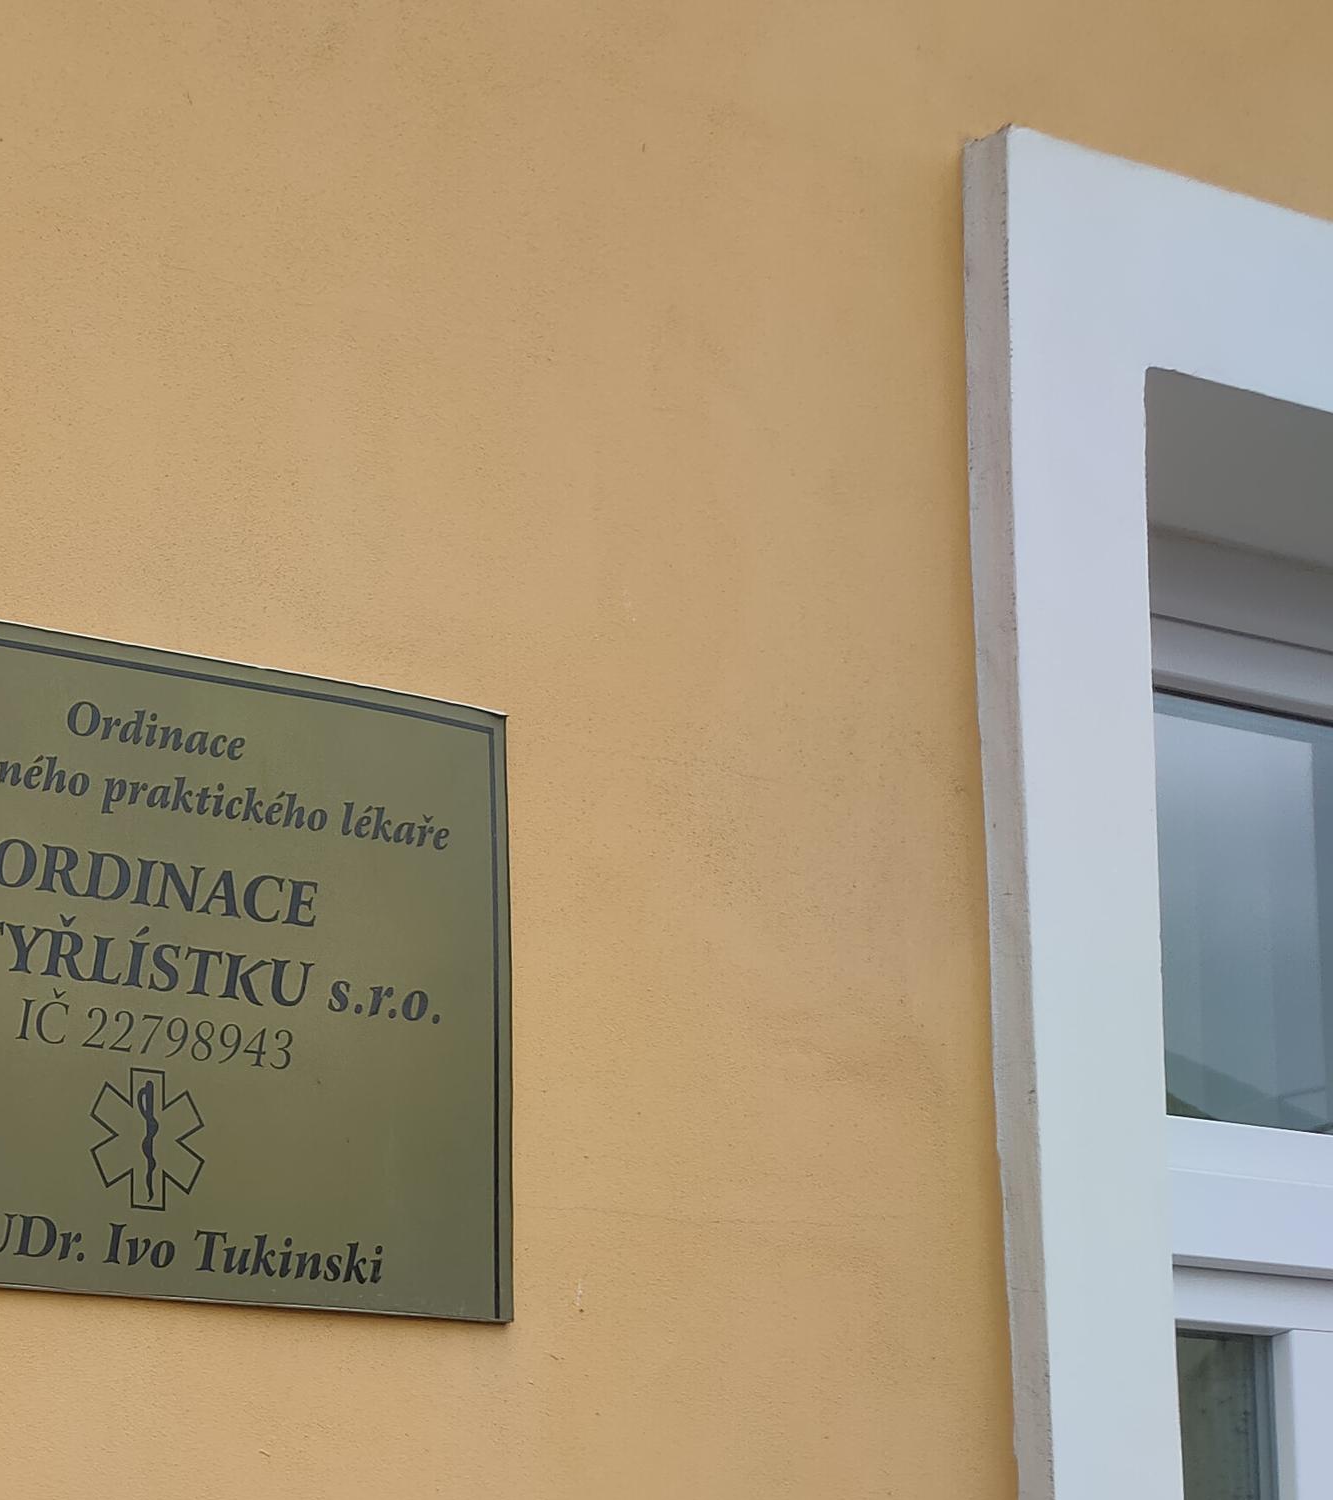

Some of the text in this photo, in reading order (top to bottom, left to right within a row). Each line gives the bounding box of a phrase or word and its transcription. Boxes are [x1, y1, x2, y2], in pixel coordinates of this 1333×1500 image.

[66, 700, 246, 761] Ordinace
[100, 774, 328, 833] praktického
[341, 801, 450, 852] lékaře
[16, 988, 294, 1070] IČ 22798943
[327, 977, 442, 1024] s.r.o.
[105, 1222, 176, 1271] Ivo
[193, 1228, 385, 1286] Tukinski
